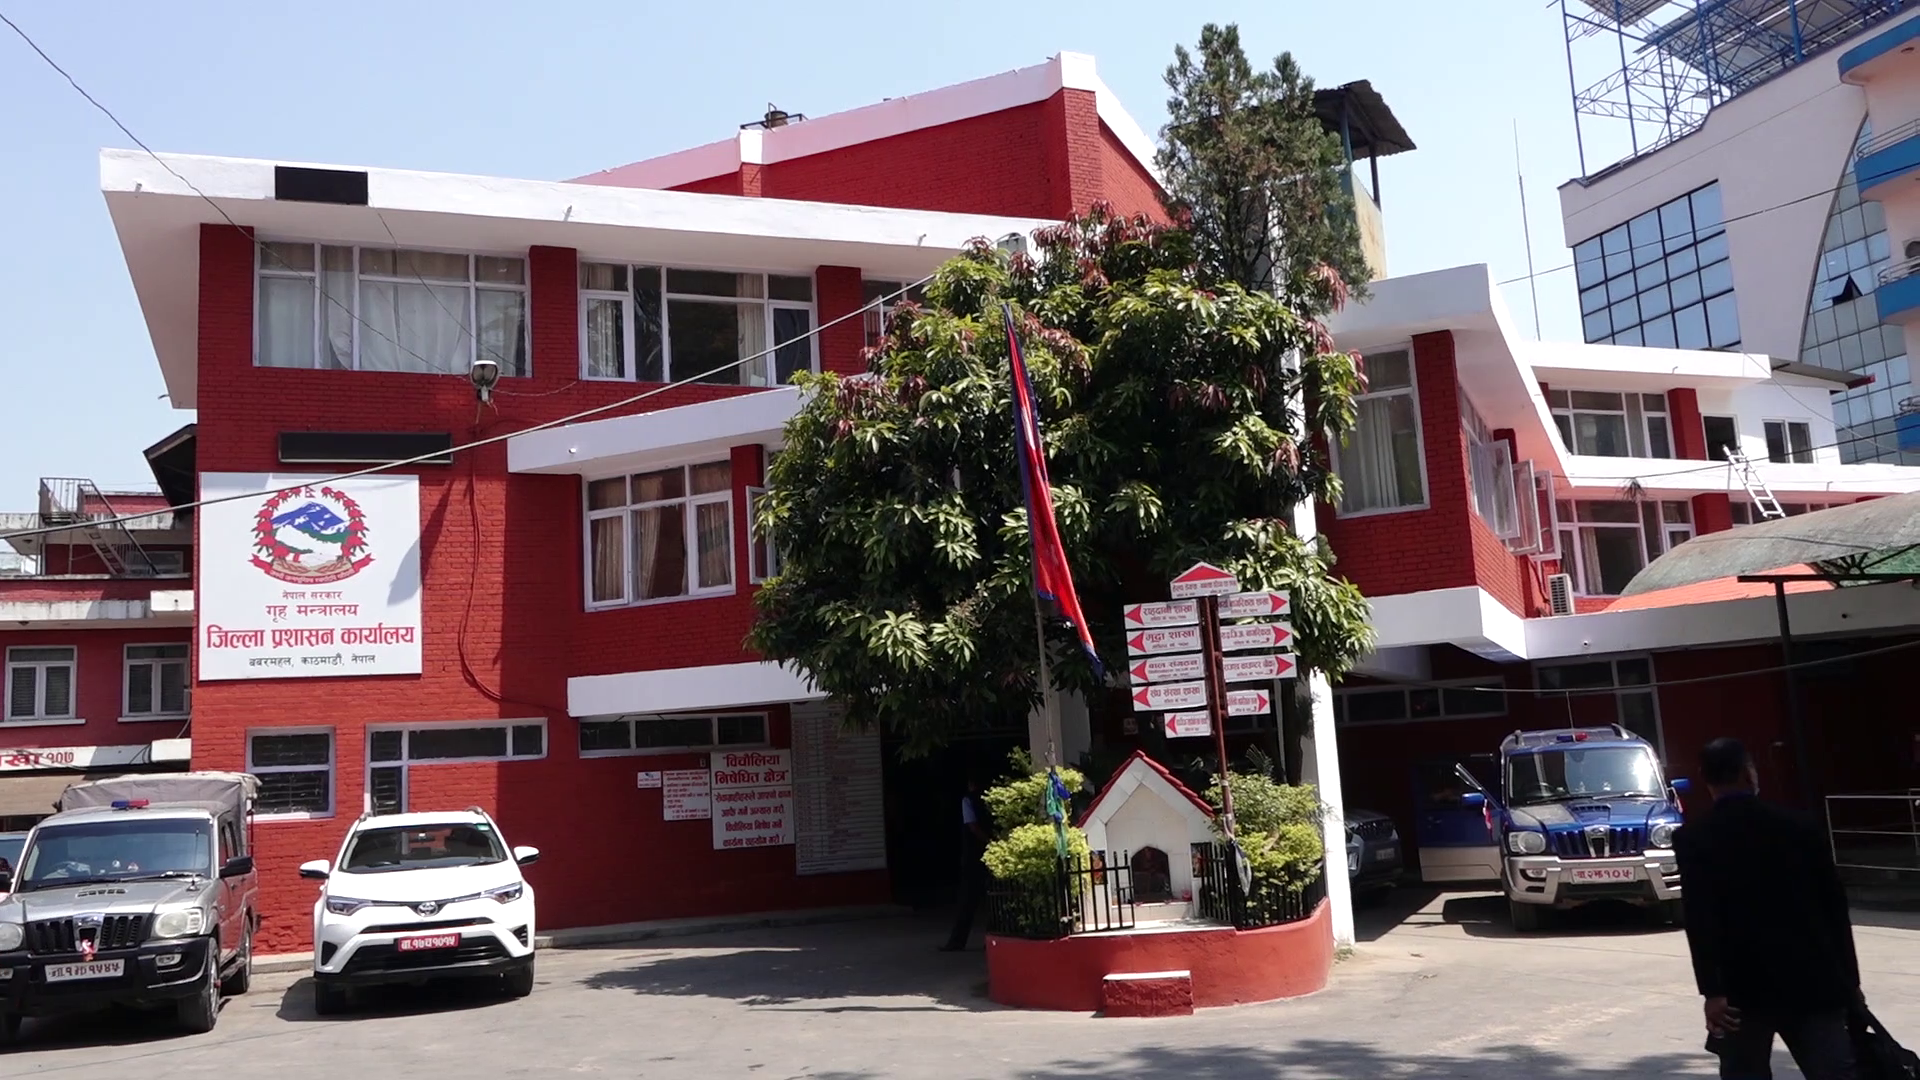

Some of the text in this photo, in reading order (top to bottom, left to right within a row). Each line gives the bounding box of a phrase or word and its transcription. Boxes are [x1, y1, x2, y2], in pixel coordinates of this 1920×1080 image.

[282, 589, 344, 600] नेपाल सरकार
[265, 603, 360, 623] गृह मन्त्रालय
[206, 622, 415, 649] जिल्ला प्रशासन कार्यालय
[1168, 630, 1195, 640] शाखा
[351, 653, 376, 664] नेपाल
